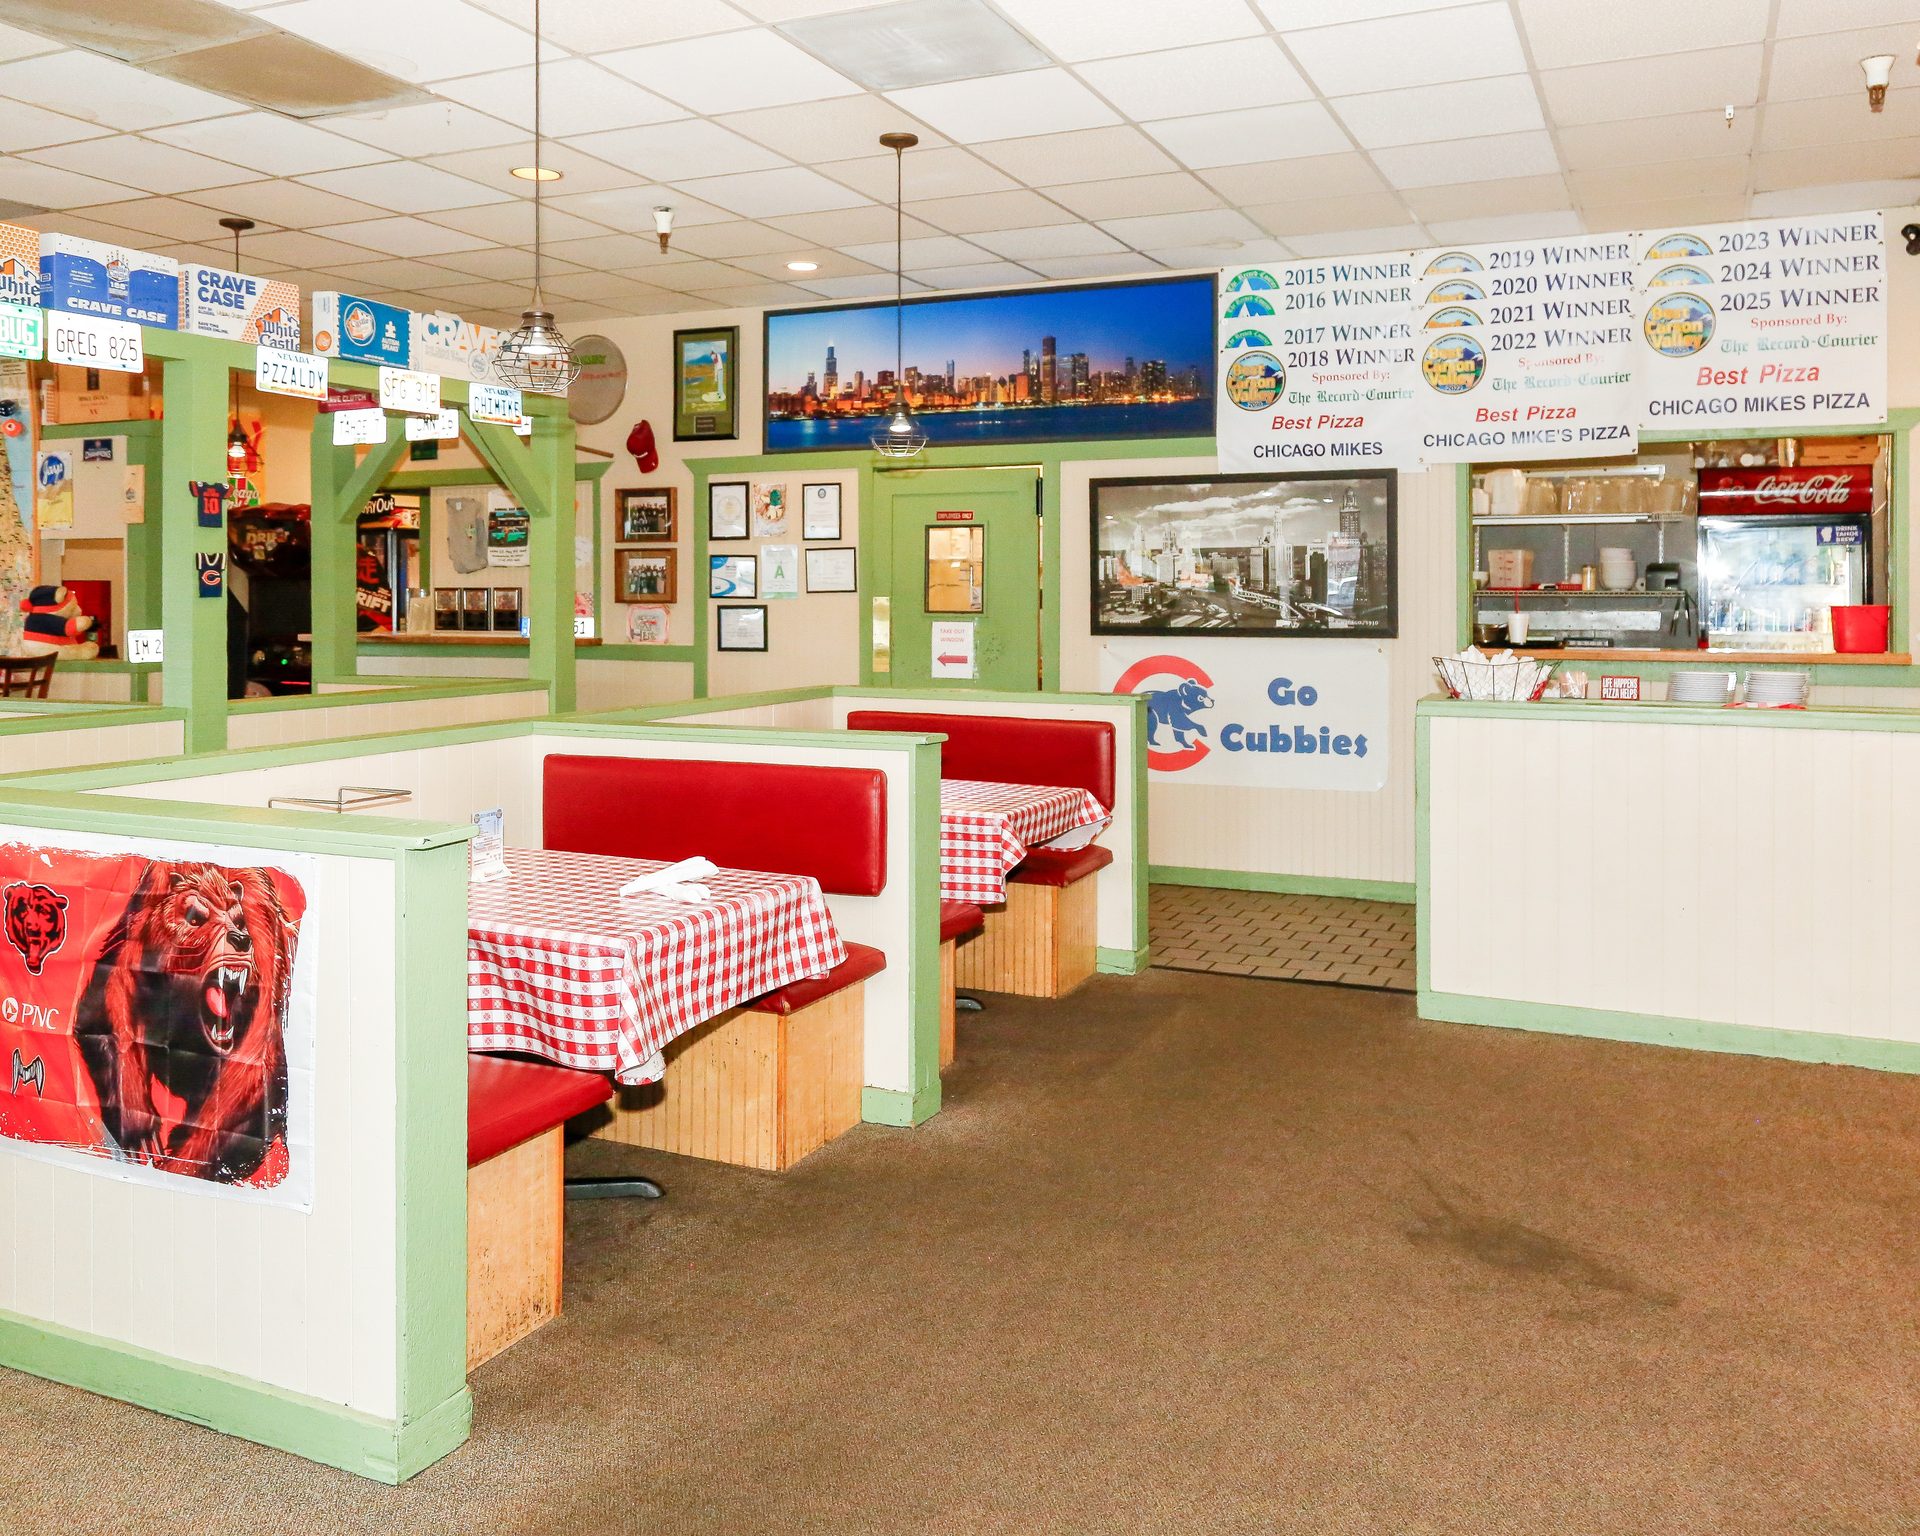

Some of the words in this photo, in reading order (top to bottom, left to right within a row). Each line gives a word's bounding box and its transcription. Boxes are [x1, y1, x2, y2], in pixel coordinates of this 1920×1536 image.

[1719, 232, 1770, 253] 2023
[1778, 224, 1878, 247] WINNER
[1490, 250, 1535, 270] 2019
[1543, 244, 1630, 265] WINNER
[1721, 263, 1771, 283] 2024
[1780, 254, 1880, 277] WINNER
[198, 270, 256, 296] CRAVE
[1285, 268, 1326, 286] 2015
[1333, 263, 1411, 282] WINNER
[1492, 277, 1538, 296] 2020
[1545, 271, 1633, 291] WINNER
[198, 287, 245, 310] CASE
[1285, 291, 1326, 310] 2016
[1333, 287, 1411, 307] WINNER
[1720, 292, 1771, 311] 2025
[1780, 287, 1880, 308] WINNER
[67, 297, 122, 315] CRAVE
[126, 308, 167, 324] CASE
[1491, 306, 1535, 324] 2021
[1543, 298, 1631, 319] WINNER
[1751, 315, 1822, 331] Sponsored
[1826, 313, 1848, 326] By:
[262, 320, 300, 338] White
[422, 313, 497, 354] CRAVE
[1284, 327, 1326, 345] 2017
[1332, 324, 1411, 342] WINNER
[1491, 333, 1537, 351] 2022
[1544, 327, 1632, 348] WINNER
[56, 328, 97, 358] GREG
[109, 336, 138, 362] 825
[1720, 339, 1748, 355] The
[278, 353, 309, 364] NEVADA
[1288, 350, 1329, 368] 2018
[1335, 348, 1415, 366] WINNER
[263, 362, 323, 390] PZZALDY
[1312, 371, 1369, 385] Sponsored
[1373, 370, 1391, 382] By:
[1492, 378, 1518, 393] The
[1696, 367, 1749, 386] Best
[1759, 363, 1820, 384] Pizza
[384, 377, 408, 400] SFG
[416, 379, 438, 403] 315
[1288, 391, 1312, 406] The
[1475, 407, 1519, 423] Best
[1527, 405, 1577, 421] Pizza
[1649, 398, 1738, 416] CHICAGO
[1744, 395, 1806, 412] MIKES
[1813, 393, 1870, 410] PIZZA
[1272, 416, 1313, 430] Best
[1317, 414, 1364, 429] Pizza
[1424, 432, 1505, 448] CHICAGO
[1511, 428, 1573, 445] MIKE'S
[1579, 425, 1631, 442] PIZZA
[1253, 444, 1326, 458] CHICAGO
[1330, 442, 1383, 456] MIKES
[1754, 474, 1853, 504] Coca-Cola
[203, 498, 220, 514] 10
[774, 565, 785, 579] A
[1267, 677, 1318, 706] Go
[1220, 723, 1368, 758] Cubbies
[22, 1003, 60, 1030] PNC
